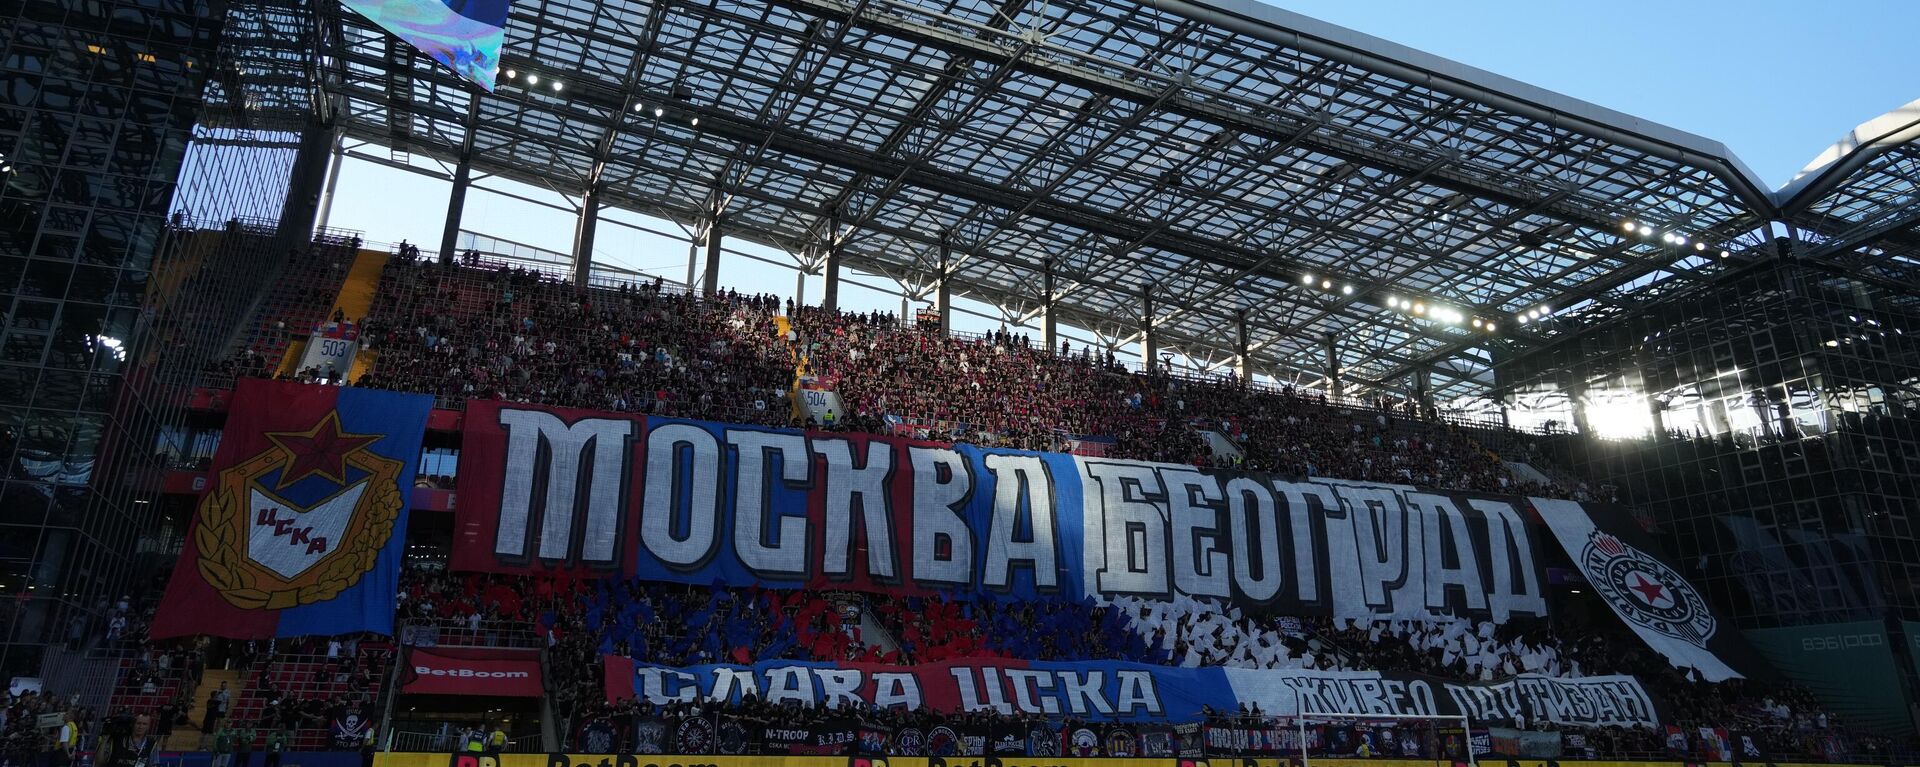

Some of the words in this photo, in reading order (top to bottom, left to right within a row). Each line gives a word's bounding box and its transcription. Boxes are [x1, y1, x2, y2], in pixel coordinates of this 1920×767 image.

[321, 340, 346, 357] 503
[807, 391, 826, 407] 504
[494, 408, 1062, 590] МОСКВА
[1085, 461, 1548, 624] БЕОГРАД
[256, 508, 327, 555] ЦСКА
[415, 666, 528, 678] BetBoom
[636, 665, 927, 714] СЛАВА
[950, 665, 1166, 717] ЦСКА
[1283, 676, 1438, 716] ЖИВЕО
[765, 728, 809, 741] N-TROOP
[1209, 727, 1249, 753] ЛЮДИ
[1253, 729, 1262, 750] В
